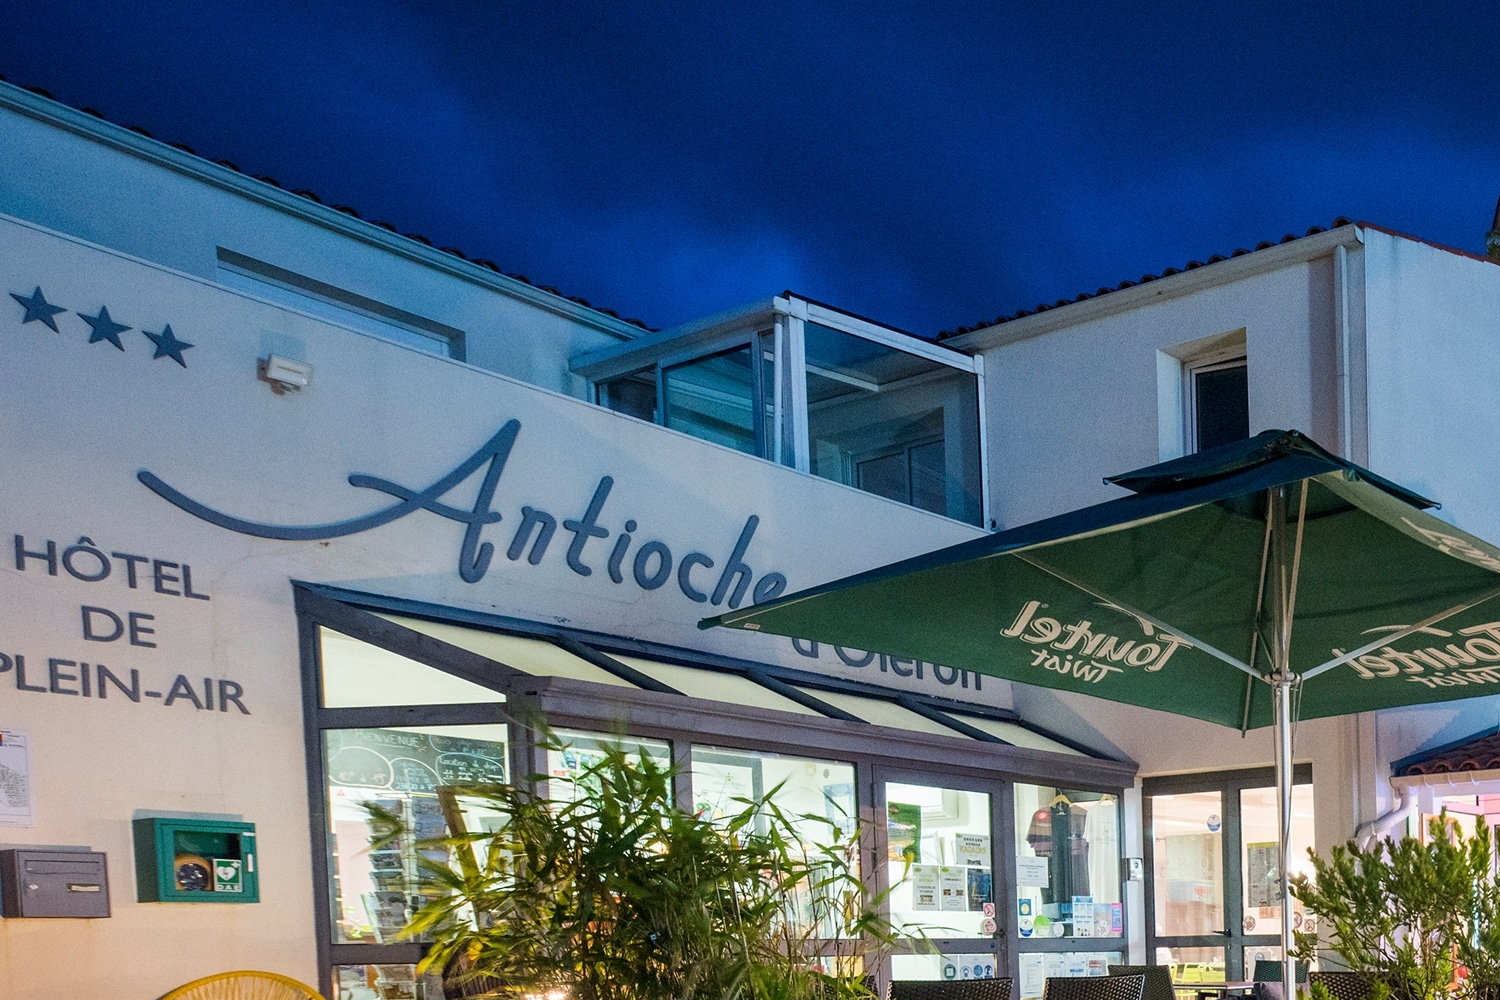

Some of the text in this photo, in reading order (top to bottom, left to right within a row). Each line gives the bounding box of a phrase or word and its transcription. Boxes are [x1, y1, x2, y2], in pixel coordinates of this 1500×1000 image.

[137, 418, 788, 609] Antioche
[14, 534, 211, 601] HÔTEL
[81, 604, 157, 649] DE
